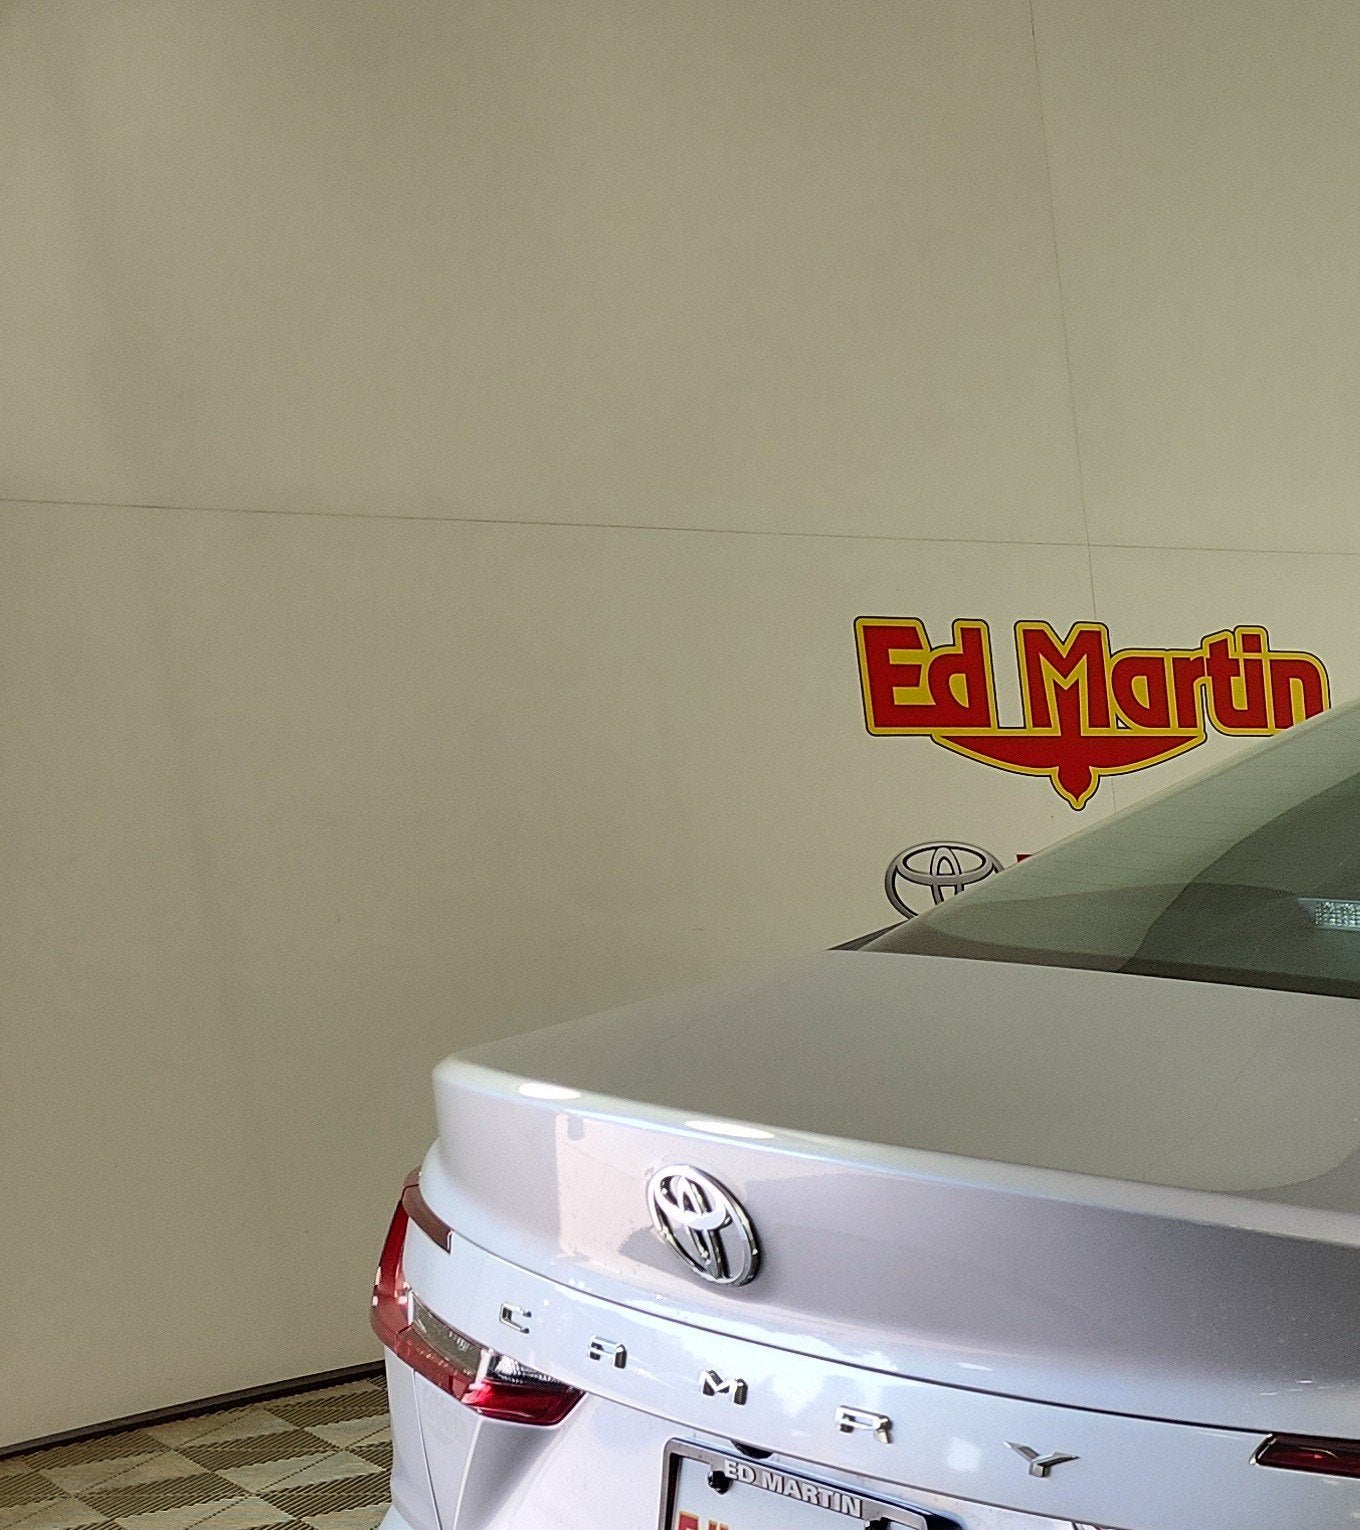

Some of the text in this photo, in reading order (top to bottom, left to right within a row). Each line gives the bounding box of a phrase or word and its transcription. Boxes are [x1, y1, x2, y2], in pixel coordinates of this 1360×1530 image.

[857, 619, 1329, 735] Ed Martin
[499, 1302, 1080, 1478] CAMRY
[725, 1459, 864, 1519] ED MARTIN
